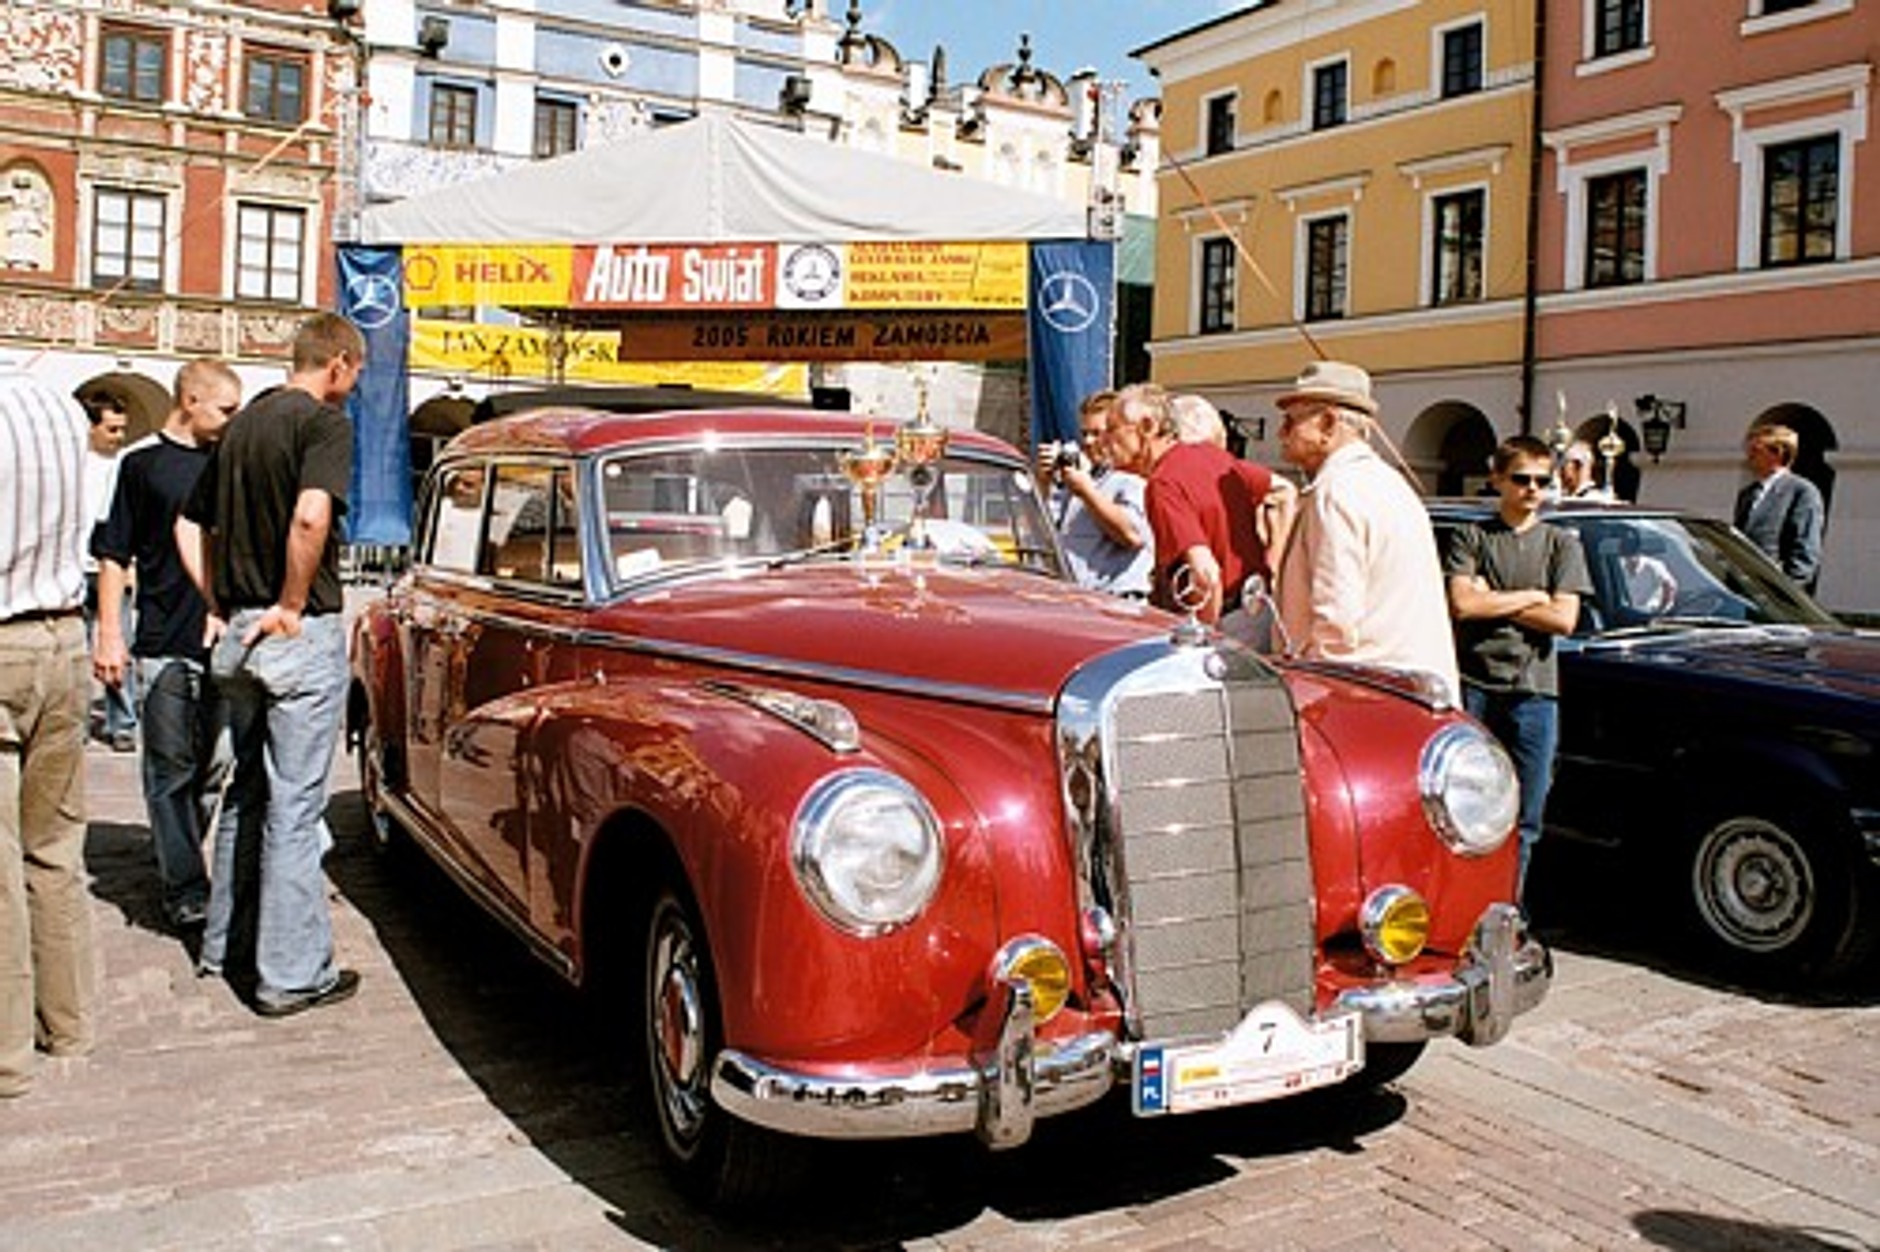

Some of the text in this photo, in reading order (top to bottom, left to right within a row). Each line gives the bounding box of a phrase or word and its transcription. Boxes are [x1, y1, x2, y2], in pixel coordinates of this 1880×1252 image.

[455, 257, 553, 283] HELIX
[584, 242, 670, 302] Auto
[692, 326, 748, 347] 2005
[767, 325, 857, 347] ROKIEM
[1259, 1022, 1277, 1053] 7
